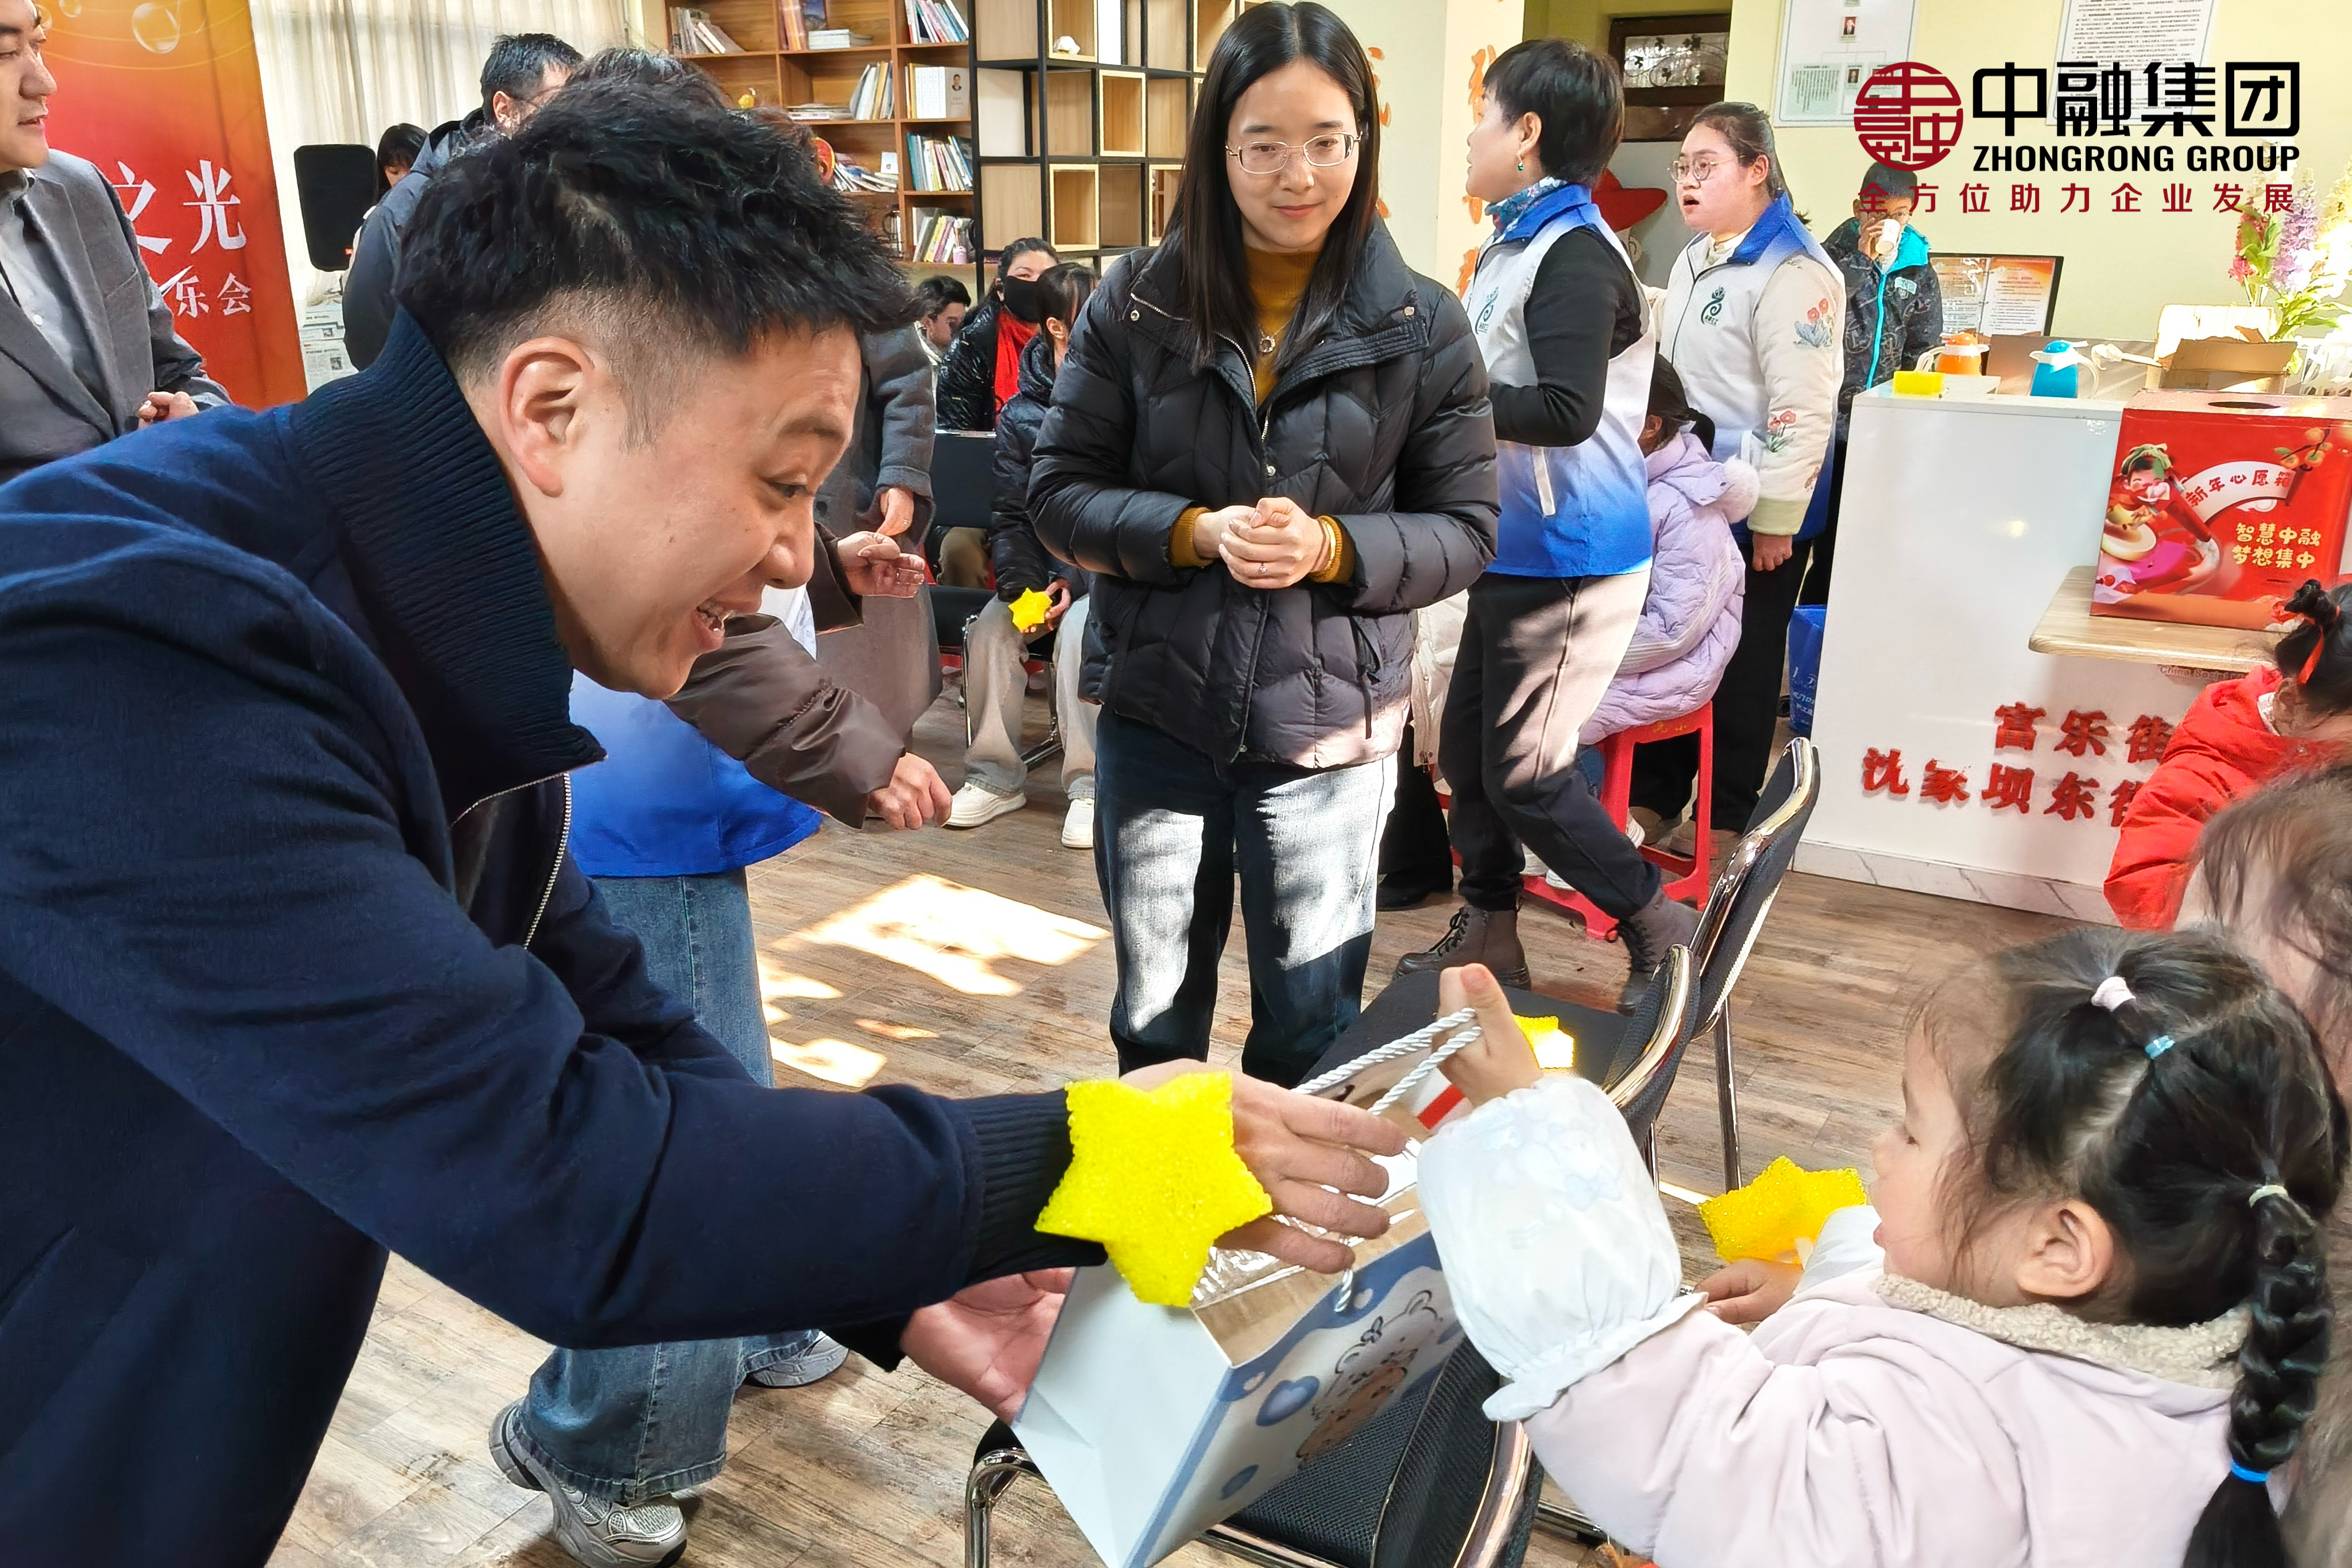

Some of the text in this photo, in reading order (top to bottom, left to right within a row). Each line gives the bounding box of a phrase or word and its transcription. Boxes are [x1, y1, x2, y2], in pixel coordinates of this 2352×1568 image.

[175, 272, 251, 318] 乐会
[2185, 469, 2292, 508] 新年心愿箱
[2235, 522, 2321, 546] 智慧中融
[2232, 544, 2315, 568] 梦想集中
